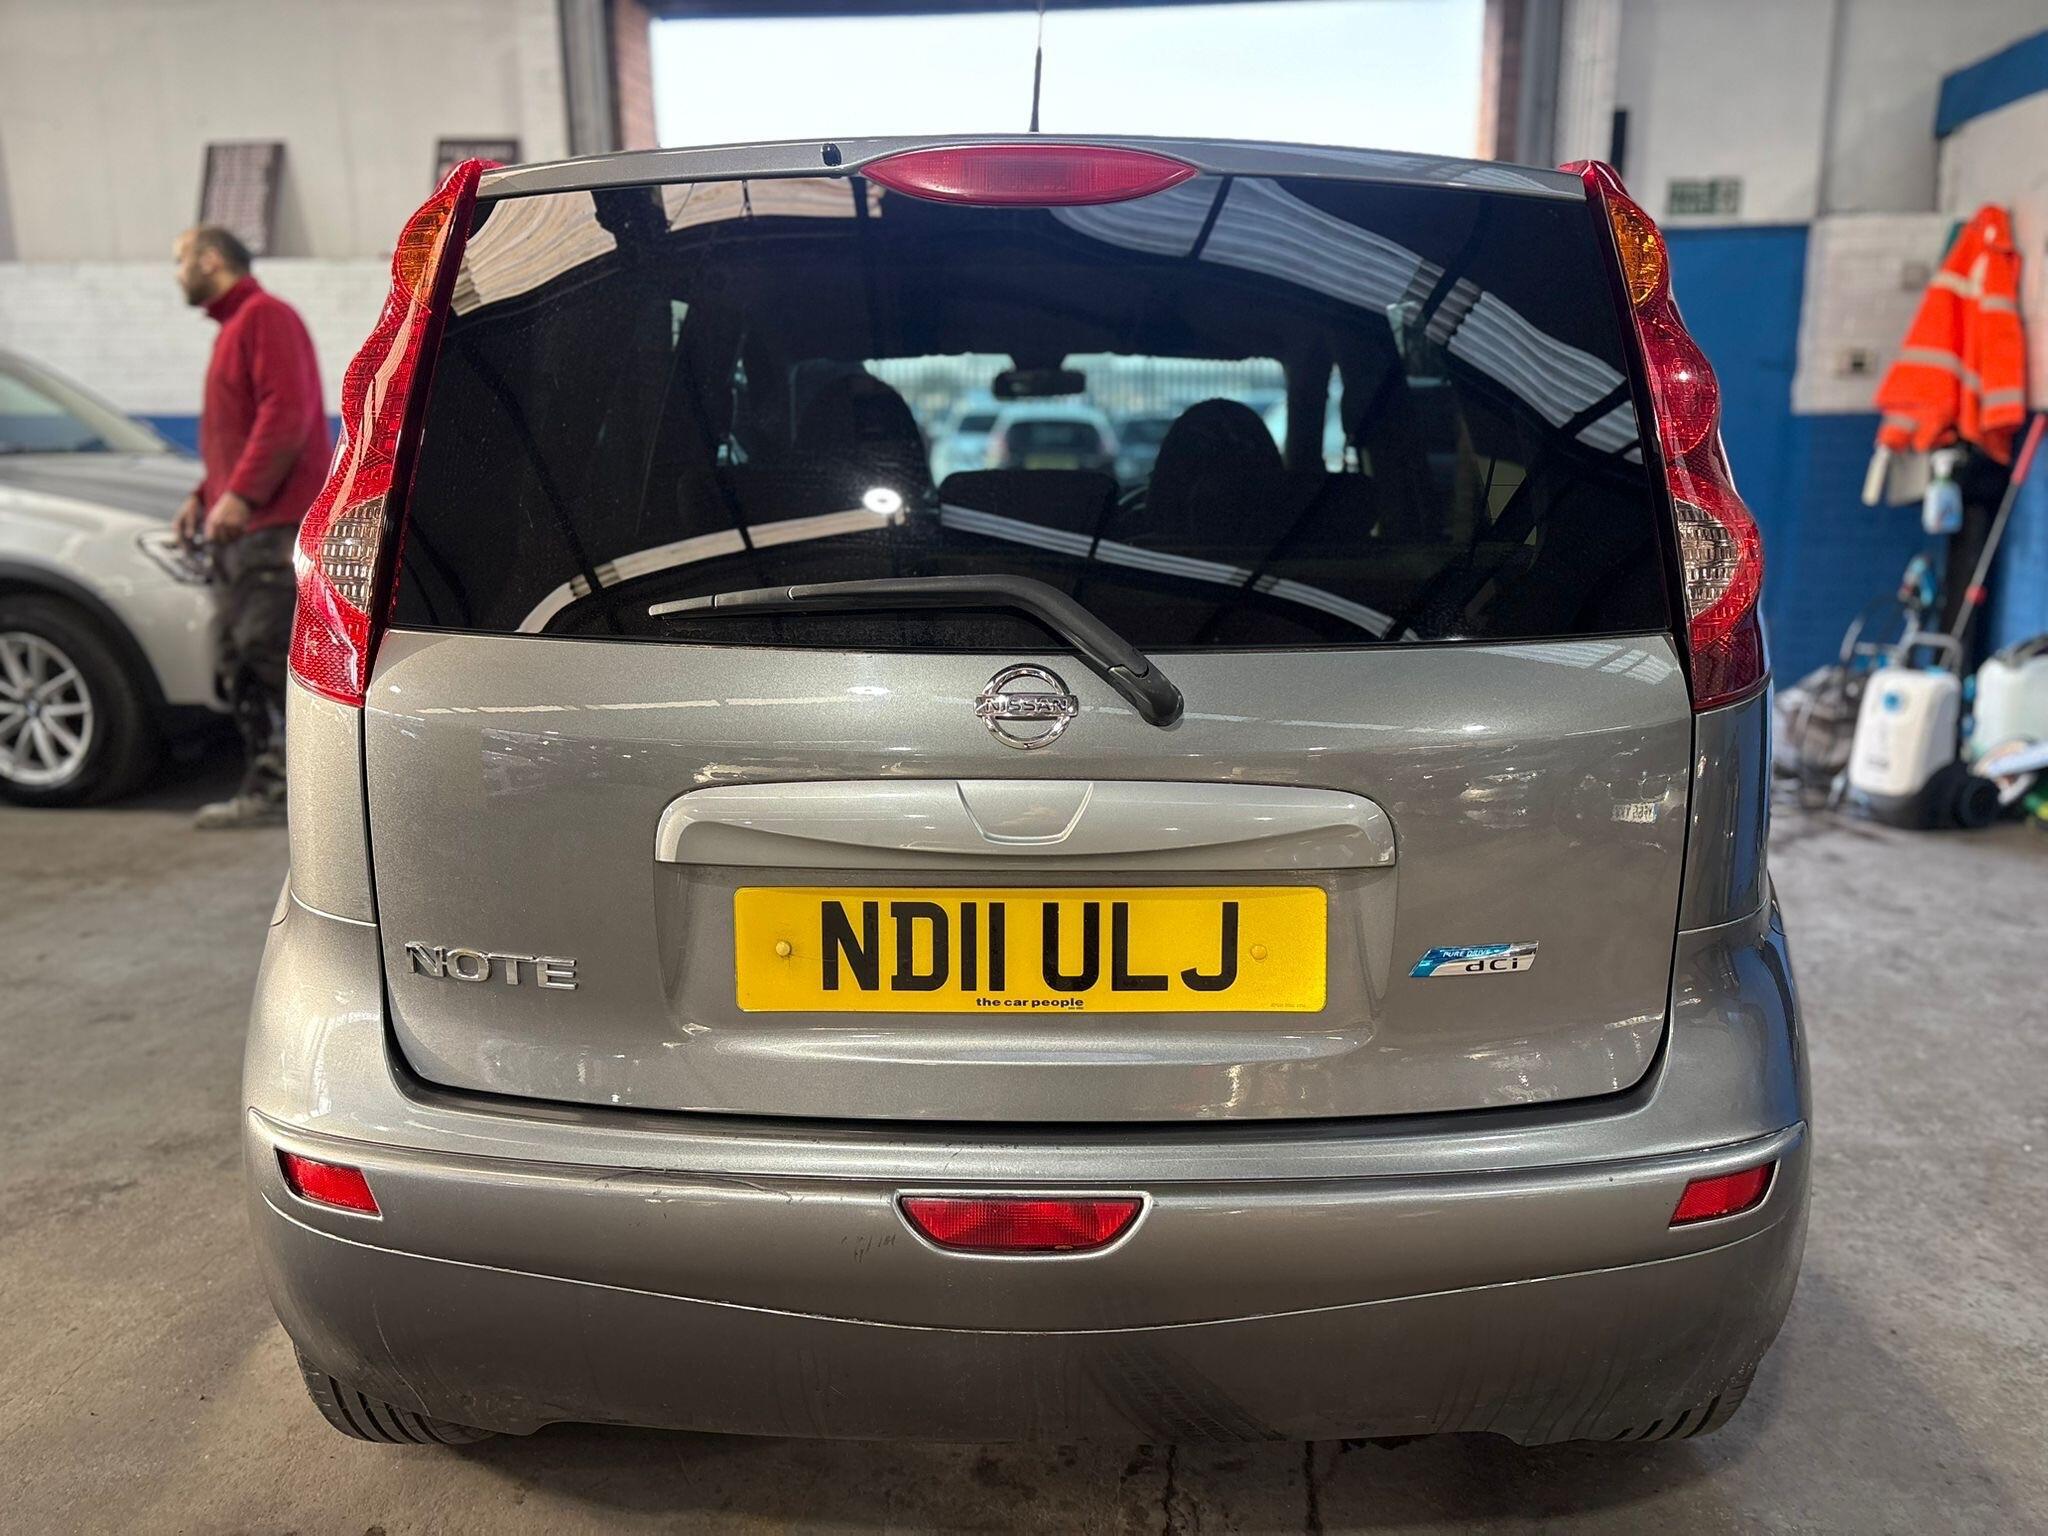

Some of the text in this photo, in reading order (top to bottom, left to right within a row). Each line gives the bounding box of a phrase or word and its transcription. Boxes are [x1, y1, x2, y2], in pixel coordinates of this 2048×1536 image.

[985, 698, 1068, 712] NISSAN
[821, 901, 1239, 992] ND11 ULJ
[1442, 950, 1464, 958] PURE
[404, 941, 577, 990] NOTE
[1465, 958, 1518, 972] dCi
[976, 997, 1001, 1006] the
[1031, 998, 1084, 1008] people
